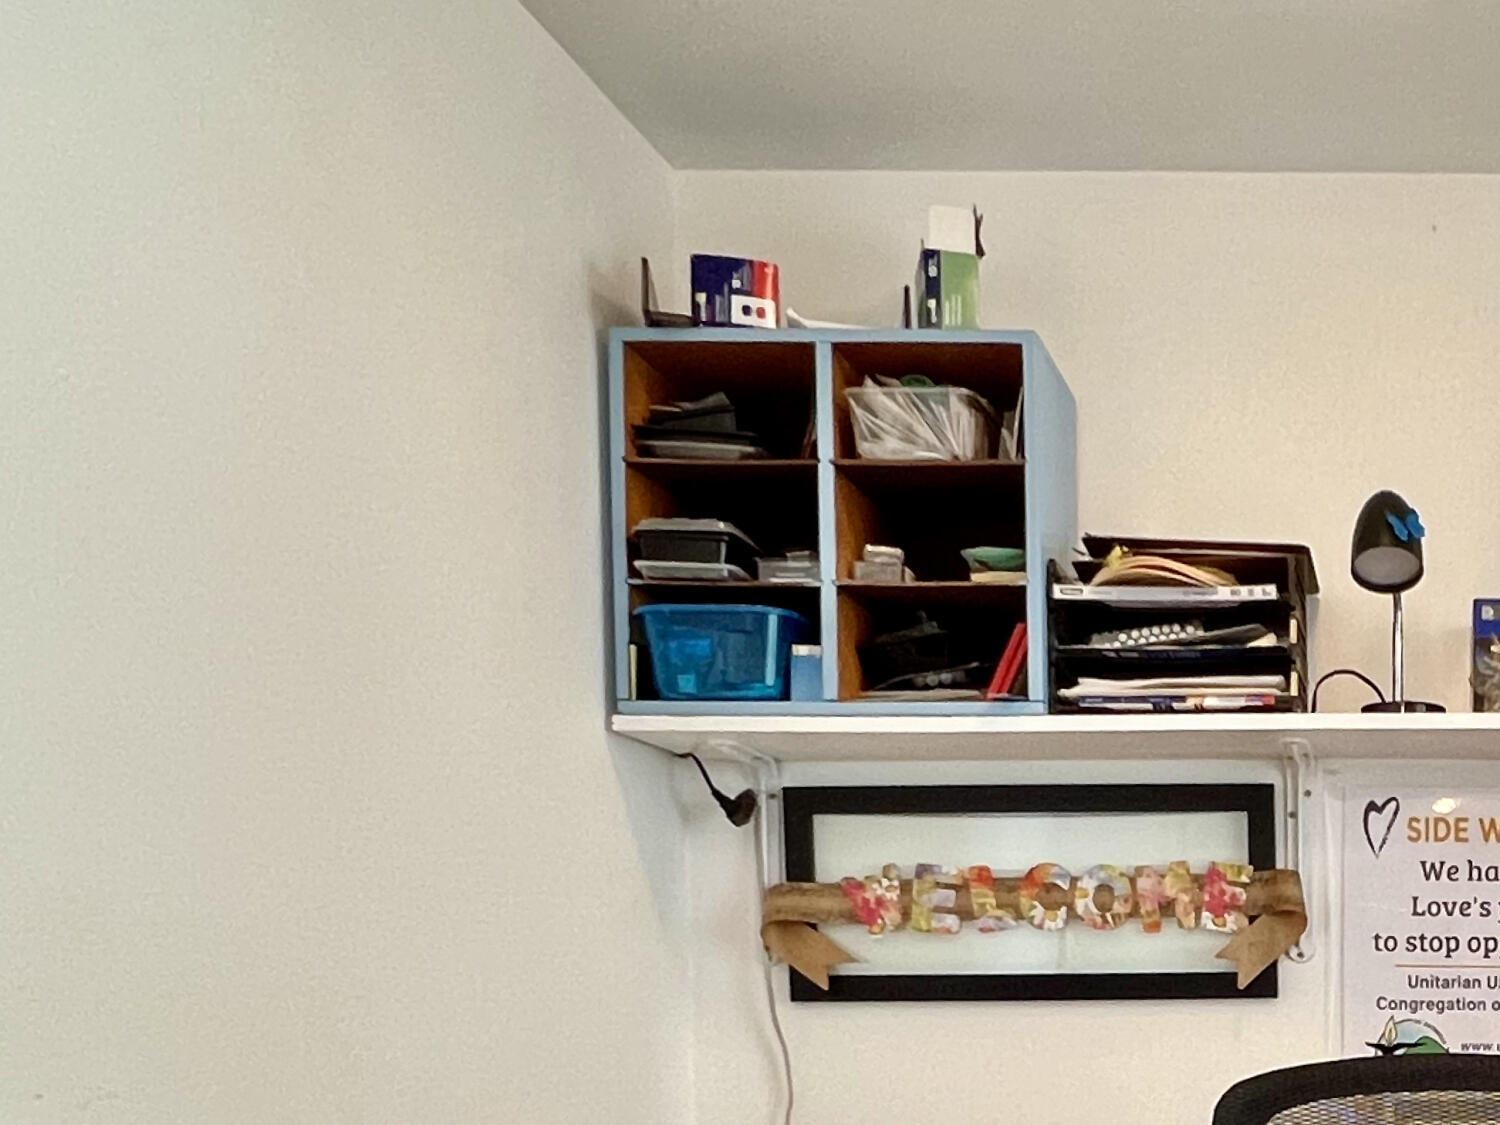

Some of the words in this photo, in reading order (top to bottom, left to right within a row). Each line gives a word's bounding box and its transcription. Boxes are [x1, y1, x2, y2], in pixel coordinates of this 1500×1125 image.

[1407, 816, 1470, 844] SIDE
[1420, 860, 1460, 883] We
[840, 861, 1253, 938] WELCOME
[1411, 896, 1492, 918] Love's
[1372, 933, 1398, 952] to
[1405, 933, 1460, 958] stop
[1407, 975, 1482, 990] Unitarian
[1376, 996, 1486, 1014] Congregation
